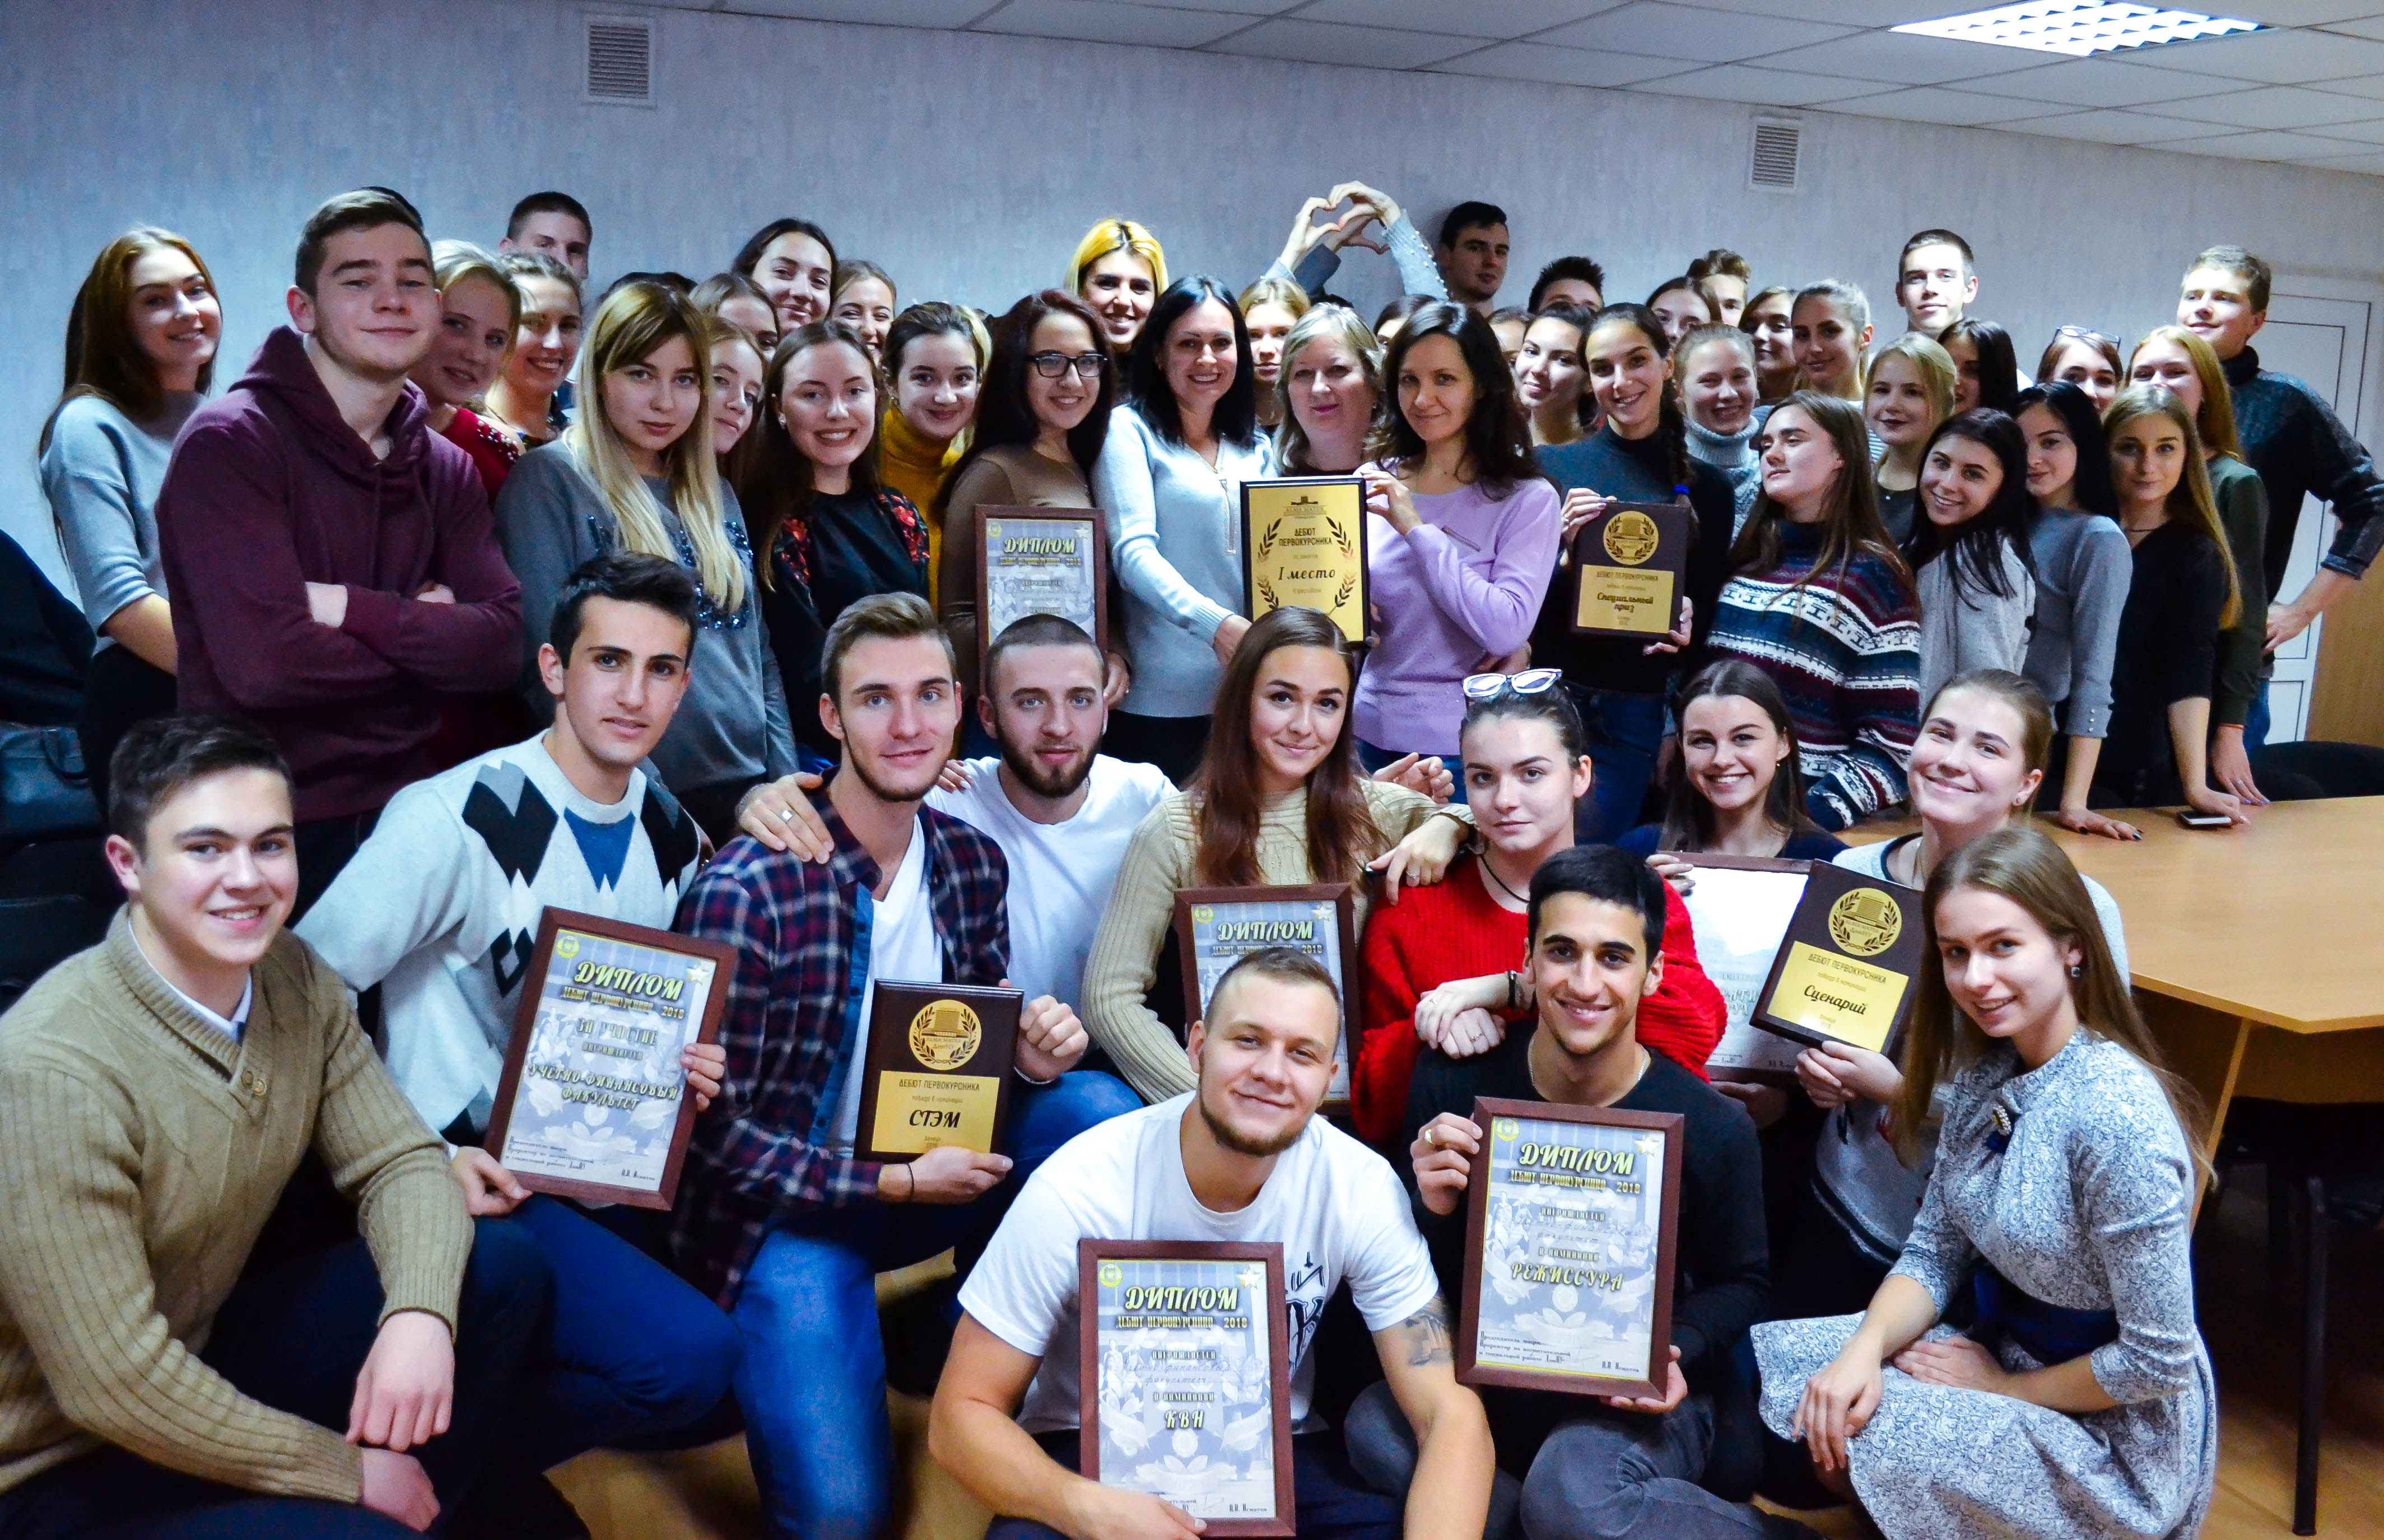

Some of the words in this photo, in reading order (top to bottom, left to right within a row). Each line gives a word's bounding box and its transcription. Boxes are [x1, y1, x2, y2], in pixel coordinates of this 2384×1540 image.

[1295, 528, 1316, 536] ДЕБЮТ
[1004, 537, 1075, 554] ДИПЛОМ
[1287, 569, 1335, 580] место
[1597, 592, 1654, 604] Специальный
[1614, 604, 1635, 613] приз
[1217, 920, 1314, 942] ДИПЛОМ
[1808, 954, 1831, 966] ДЕБЮТ
[1832, 960, 1887, 983] ПЕРВОКУРСНИКА
[574, 961, 685, 1001] ДИПЛОМ
[1804, 984, 1868, 1015] Сценарий
[578, 1018, 594, 1034] ЗА
[601, 1021, 658, 1045] УЧАСТИЕ
[899, 1079, 921, 1088] ДЕБЮТ
[924, 1080, 980, 1091] ПЕРВОКУРСНИКА
[562, 1086, 640, 1110] ФАКУЛЬТЕТ
[909, 1109, 961, 1128] СТЭМ
[1519, 1142, 1635, 1175] ДИПЛОМ
[1508, 1169, 1536, 1183] ДЕБЮТ
[1616, 1182, 1641, 1194] 2018
[1511, 1262, 1624, 1292] РЕЖИССУРА
[1125, 1286, 1238, 1313] ДИПЛОМ
[1117, 1315, 1143, 1329] ДЕБЮТ
[1223, 1317, 1248, 1329] 2018
[1165, 1410, 1204, 1429] КВН
